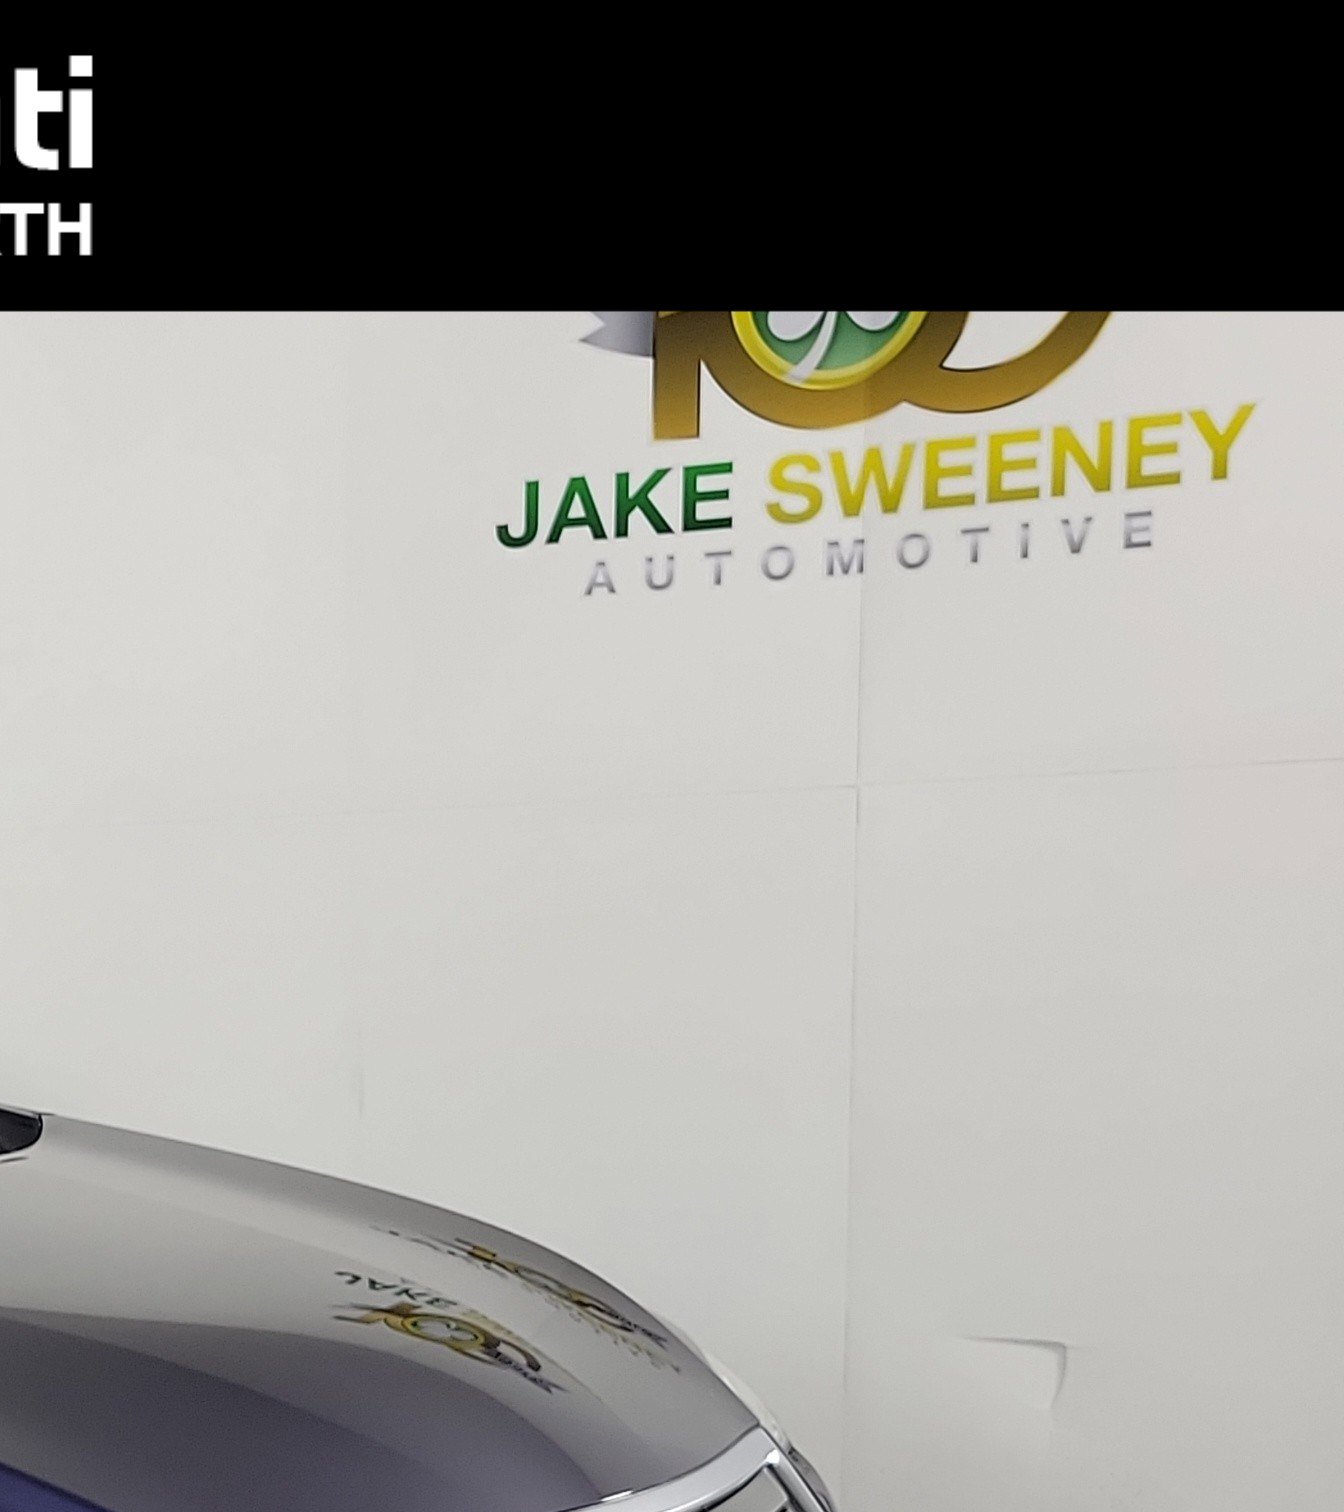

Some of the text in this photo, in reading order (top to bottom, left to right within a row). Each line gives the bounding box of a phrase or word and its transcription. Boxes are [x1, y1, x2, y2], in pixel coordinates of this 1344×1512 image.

[496, 404, 1256, 549] JAKE SWEENEY
[585, 510, 1154, 597] AUTOMOTIVE
